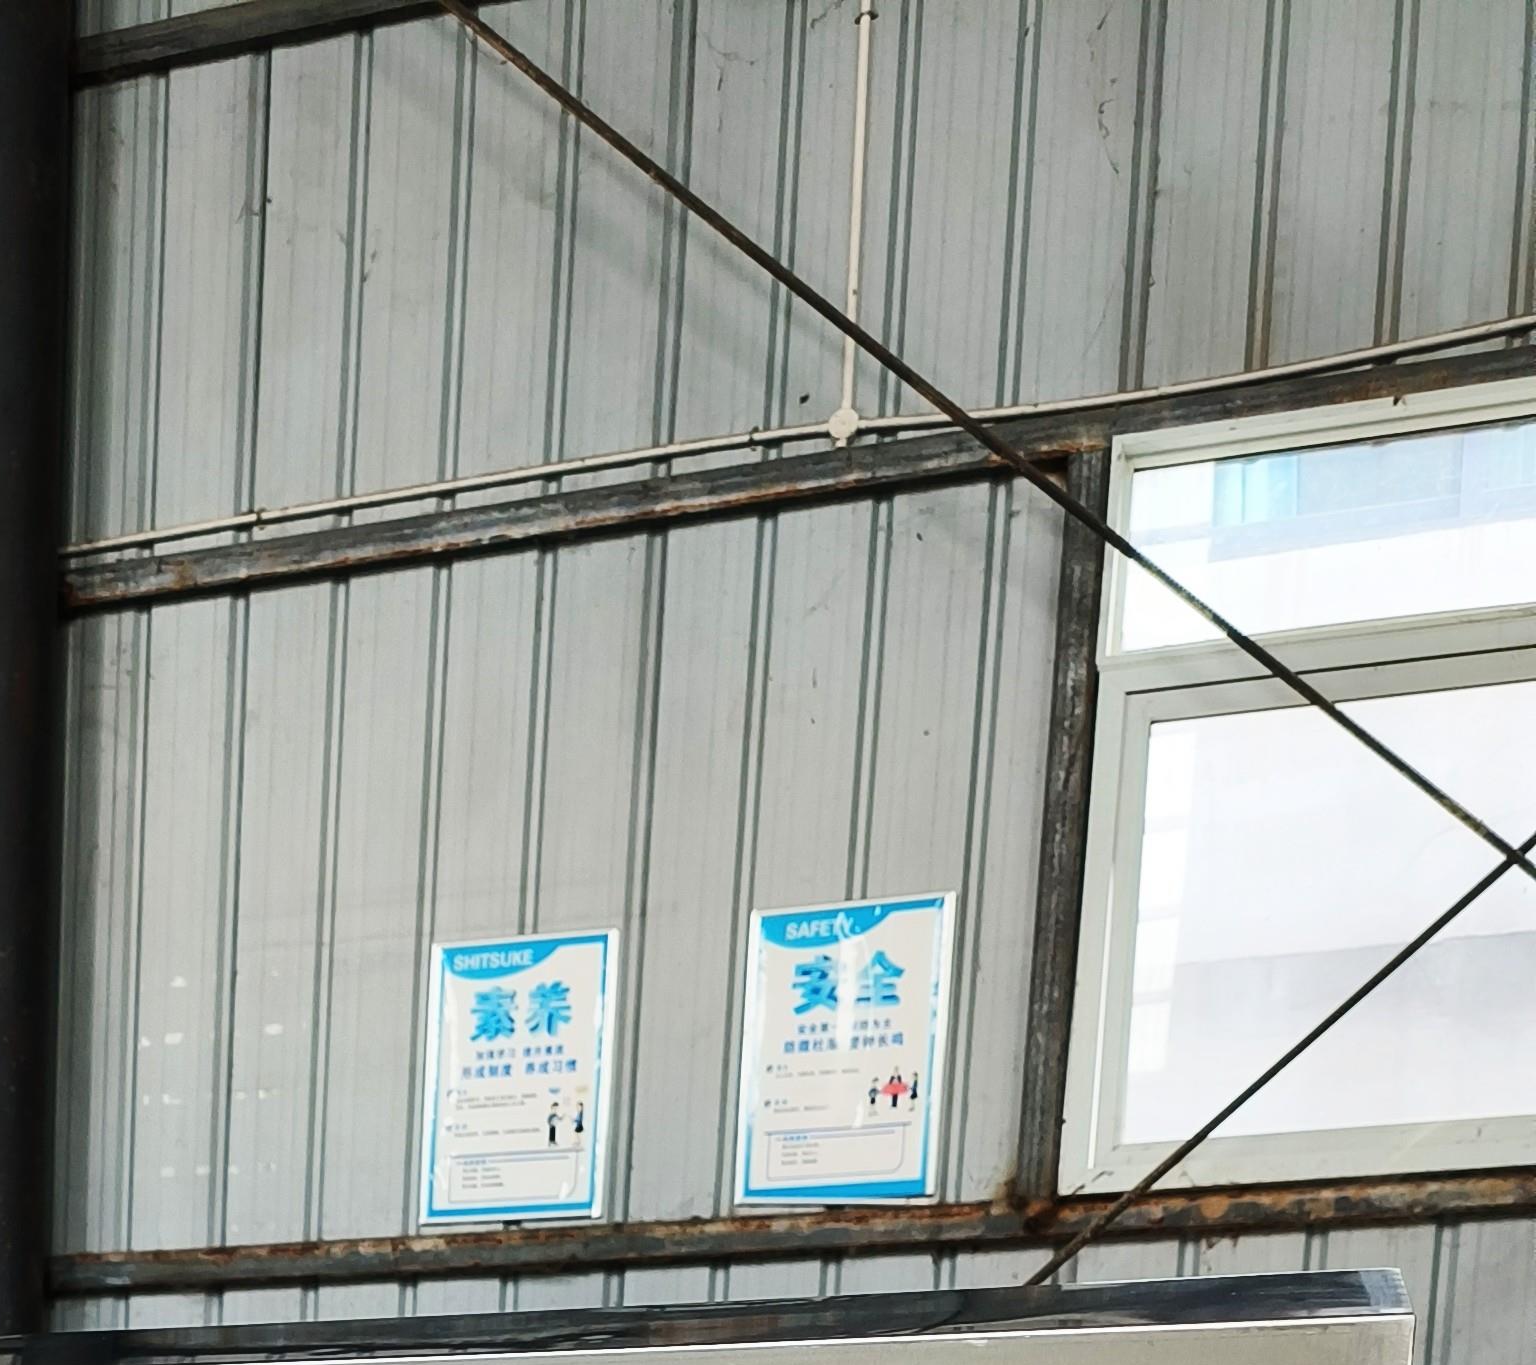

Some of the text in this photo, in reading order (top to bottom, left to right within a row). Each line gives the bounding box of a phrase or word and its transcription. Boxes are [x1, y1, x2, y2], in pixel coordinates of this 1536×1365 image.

[784, 914, 853, 941] SAFETY
[452, 948, 534, 972] SHITSUKE
[791, 950, 905, 1016] 安全
[469, 979, 572, 1042] 素养
